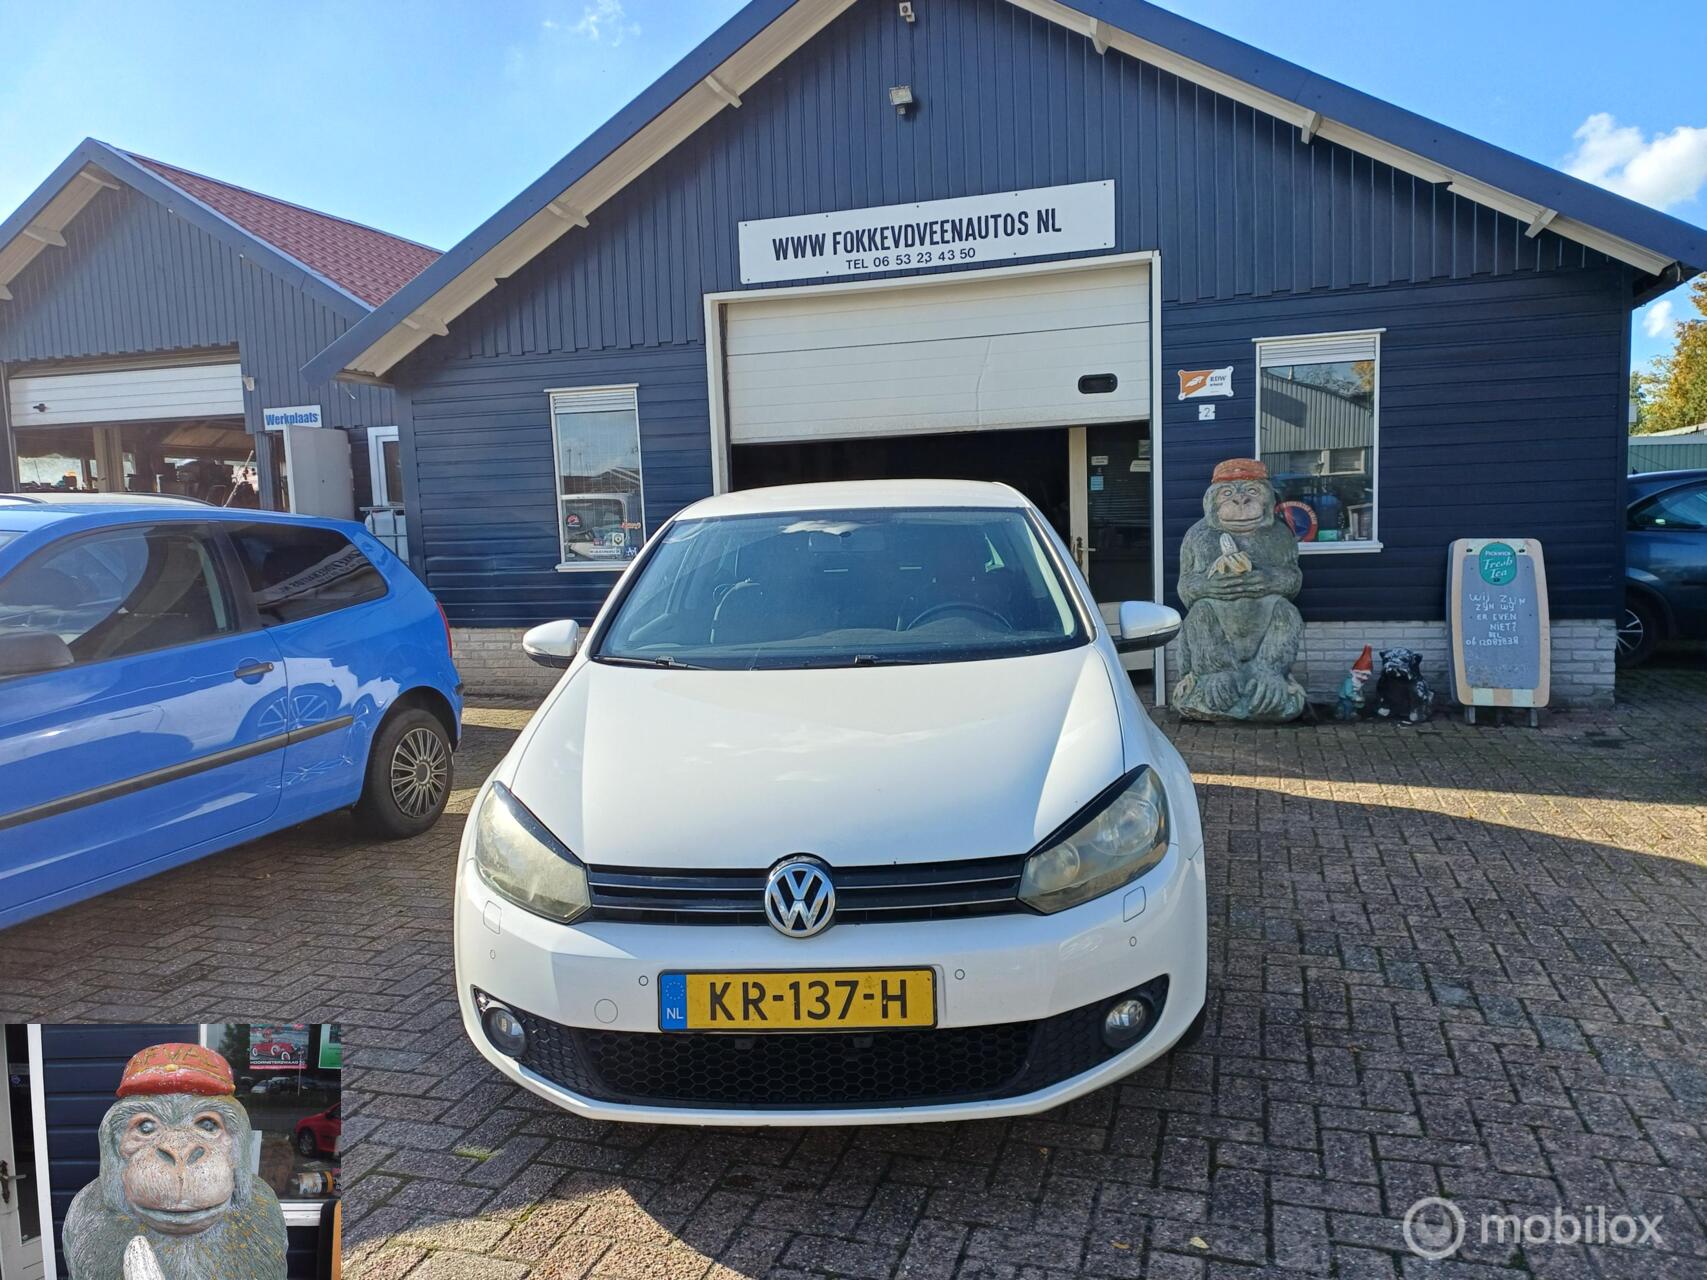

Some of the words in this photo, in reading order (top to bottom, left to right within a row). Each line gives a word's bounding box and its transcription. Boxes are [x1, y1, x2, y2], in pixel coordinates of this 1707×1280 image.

[772, 232, 826, 261] WWW
[832, 210, 1029, 256] FOKKEVDVEENAUTOS
[1037, 207, 1062, 234] NL
[846, 258, 869, 270] TEL
[873, 256, 890, 268] 06
[895, 254, 912, 266] 53
[916, 251, 932, 264] 23
[938, 249, 955, 262] 43
[960, 247, 976, 260] 50
[265, 412, 320, 426] Werkplaats
[1203, 407, 1211, 418] 2
[1490, 568, 1508, 578] Tea
[709, 979, 908, 1021] KR-137-H
[666, 1008, 684, 1020] NL
